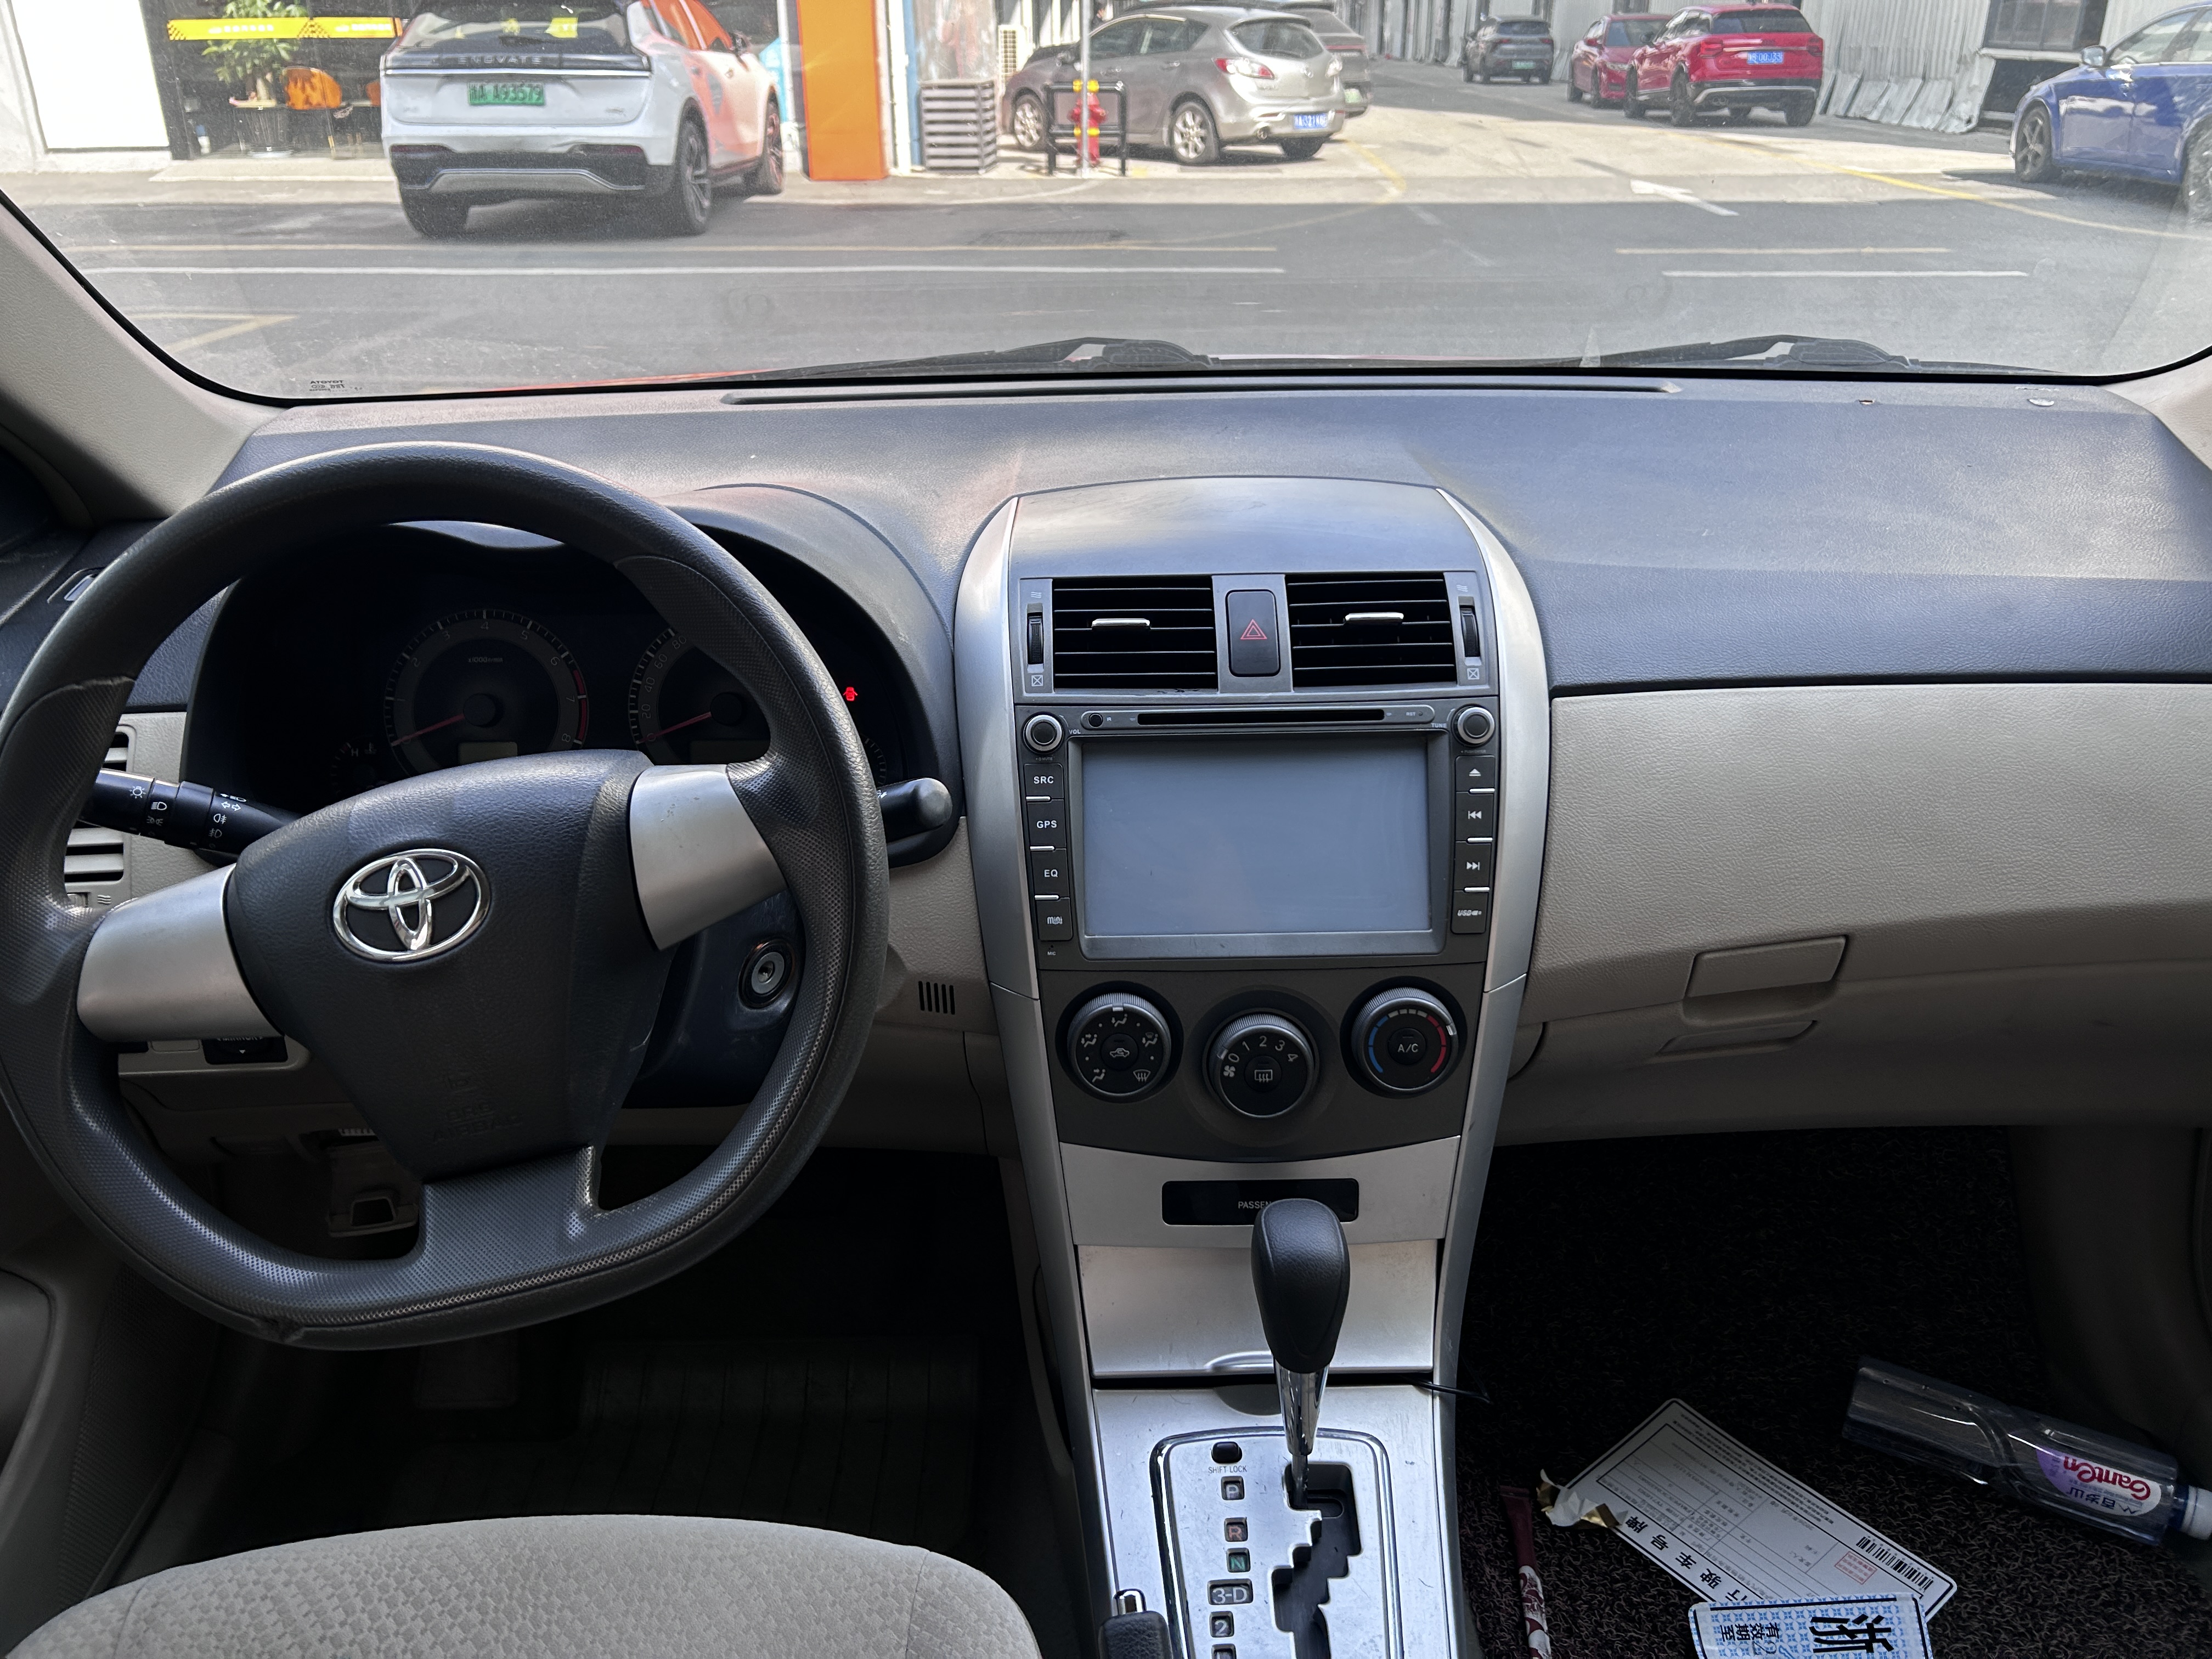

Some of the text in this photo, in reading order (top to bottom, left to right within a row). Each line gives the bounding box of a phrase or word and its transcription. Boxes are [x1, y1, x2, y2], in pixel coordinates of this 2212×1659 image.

[1033, 776, 1054, 785] SRC
[1036, 820, 1058, 829] GPS
[1044, 869, 1058, 878] EQ
[1242, 1041, 1250, 1051] 1
[1259, 1035, 1267, 1047] 2
[1274, 1040, 1285, 1051] 3
[1397, 1043, 1418, 1053] A/C
[1228, 1053, 1240, 1063] 0
[1287, 1053, 1299, 1063] 4
[1207, 1465, 1248, 1474] SHIFT LOCK
[1225, 1483, 1240, 1500] P
[2066, 1486, 2116, 1510] 百岁山
[1228, 1525, 1243, 1541] R
[1231, 1556, 1246, 1572] N
[1212, 1587, 1248, 1604] 3-D
[1215, 1620, 1229, 1637] 2
[1720, 1622, 1780, 1642] 有效期至
[1809, 1613, 1894, 1654] 浙
